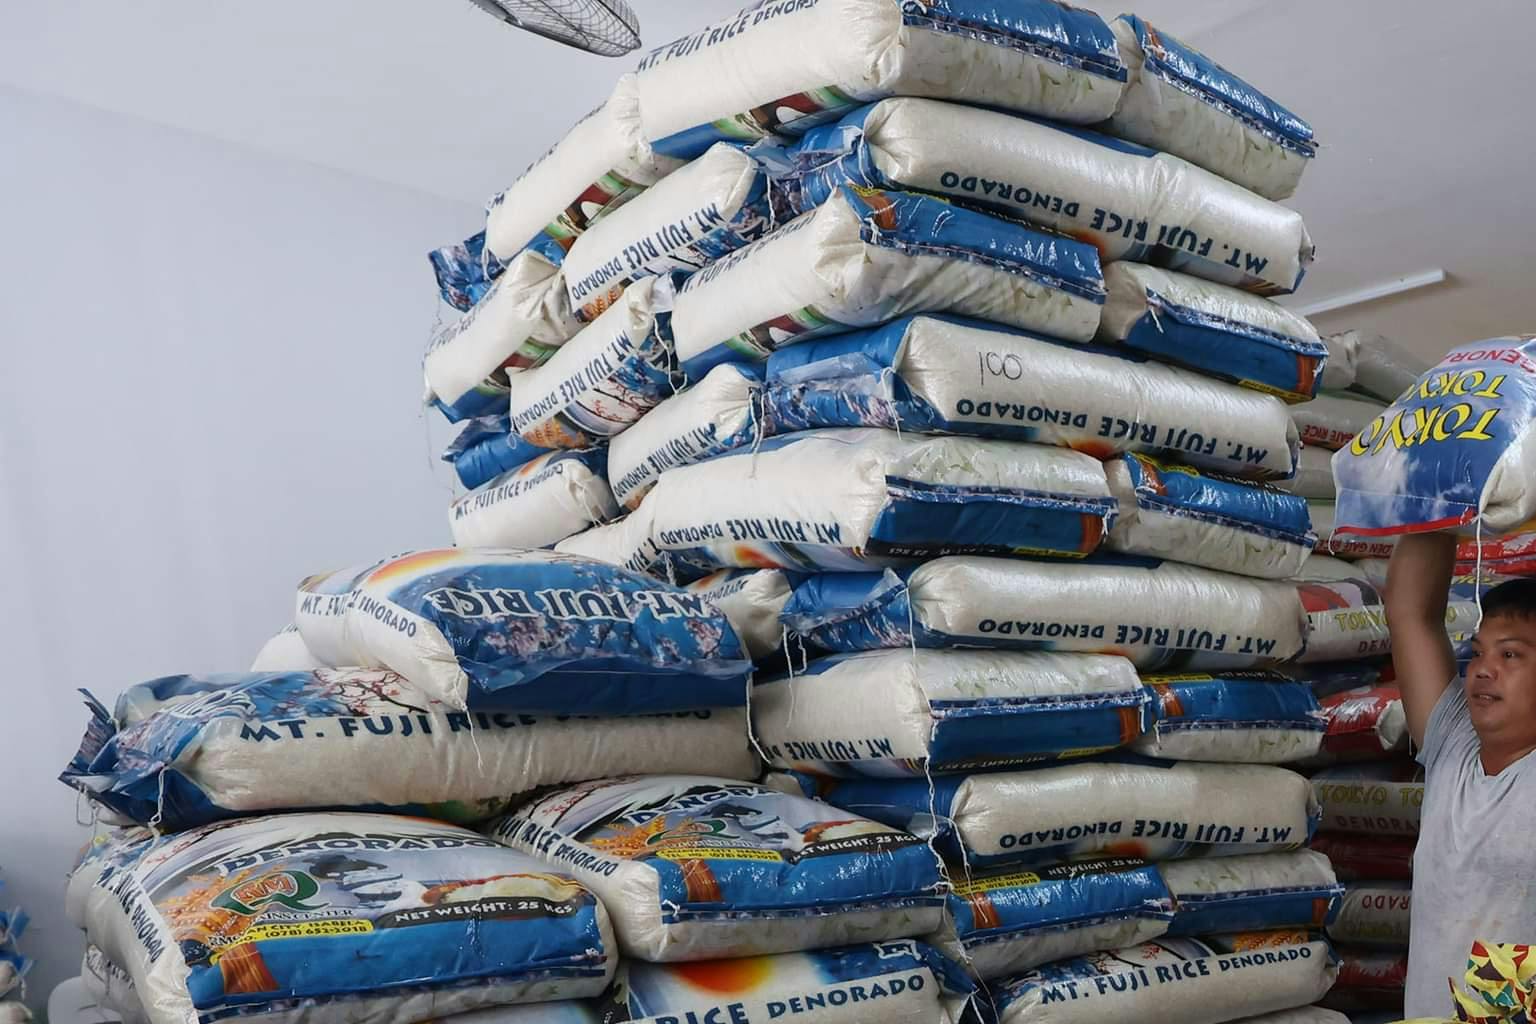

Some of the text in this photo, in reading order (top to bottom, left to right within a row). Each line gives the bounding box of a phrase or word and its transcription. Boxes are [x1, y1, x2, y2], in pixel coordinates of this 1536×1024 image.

[688, 202, 725, 233] MT.
[940, 170, 1269, 276] MT. FUJI RICE DENORADO
[656, 218, 692, 252] FUJI
[622, 238, 659, 271] RICE
[571, 257, 624, 301] DENORADO
[956, 398, 1269, 464] MT. FUJI RICE DENORADO
[1350, 404, 1502, 458] TOKYO
[660, 517, 842, 545] MT. FUJI RICE DENORADO
[422, 587, 534, 618] RICE
[540, 587, 632, 620] FUJI
[978, 618, 1277, 654] MT. FUJI RICE DENORADO
[239, 716, 326, 744] MT.
[342, 715, 431, 738] FUJI
[820, 739, 862, 761] FUJI
[859, 737, 896, 759] MT.
[522, 823, 619, 876] RICE DENORADO
[818, 835, 891, 853] WEIGHT: 25
[999, 819, 1292, 848] MT. FUJI RICE DENORADO
[395, 910, 432, 922] NET
[435, 902, 513, 916] WEIGHT:
[517, 901, 540, 910] 25
[1040, 946, 1312, 1005] MT. FUJI RICE DENORADO
[766, 973, 927, 1020] DENORADO
